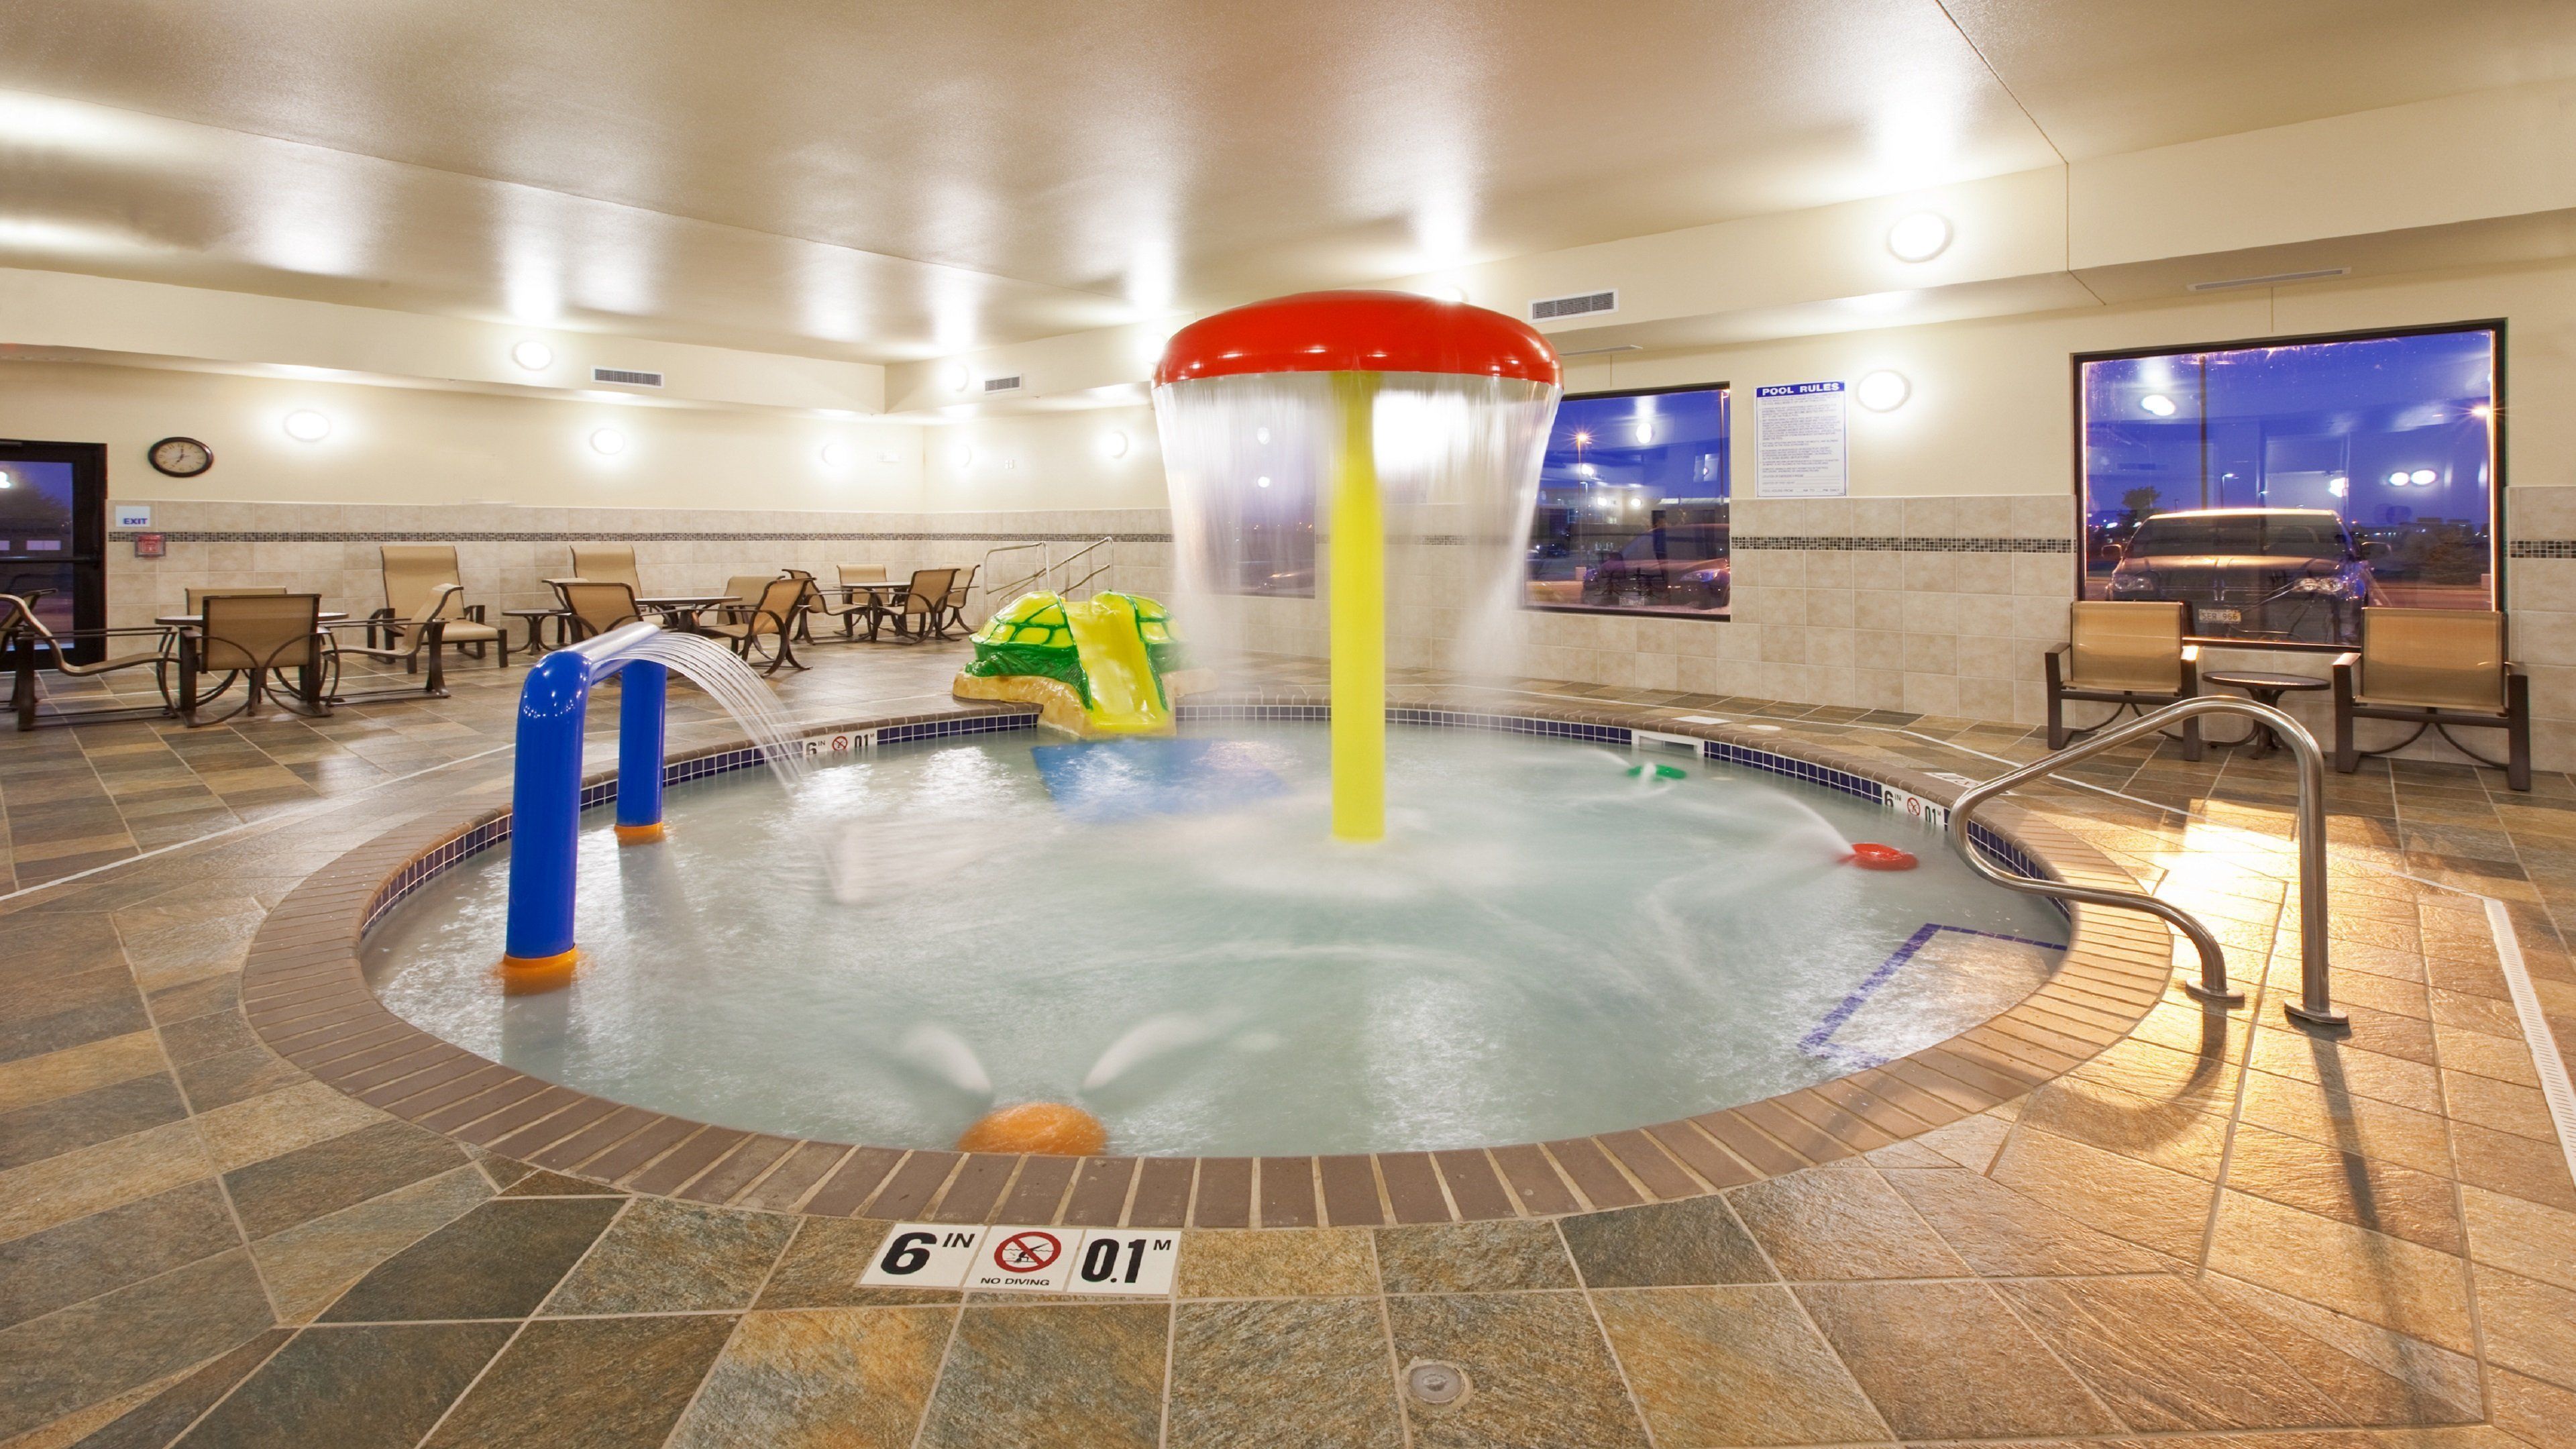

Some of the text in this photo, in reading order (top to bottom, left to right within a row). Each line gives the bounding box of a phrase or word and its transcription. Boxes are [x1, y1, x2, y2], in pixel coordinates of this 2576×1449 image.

[1762, 382, 1840, 396] POOL RULES
[806, 742, 817, 754] 6
[1884, 790, 1894, 807] 6
[879, 1232, 975, 1275] 6 IN
[1081, 1238, 1172, 1284] 0.1 M
[1005, 1277, 1050, 1286] DIVING
